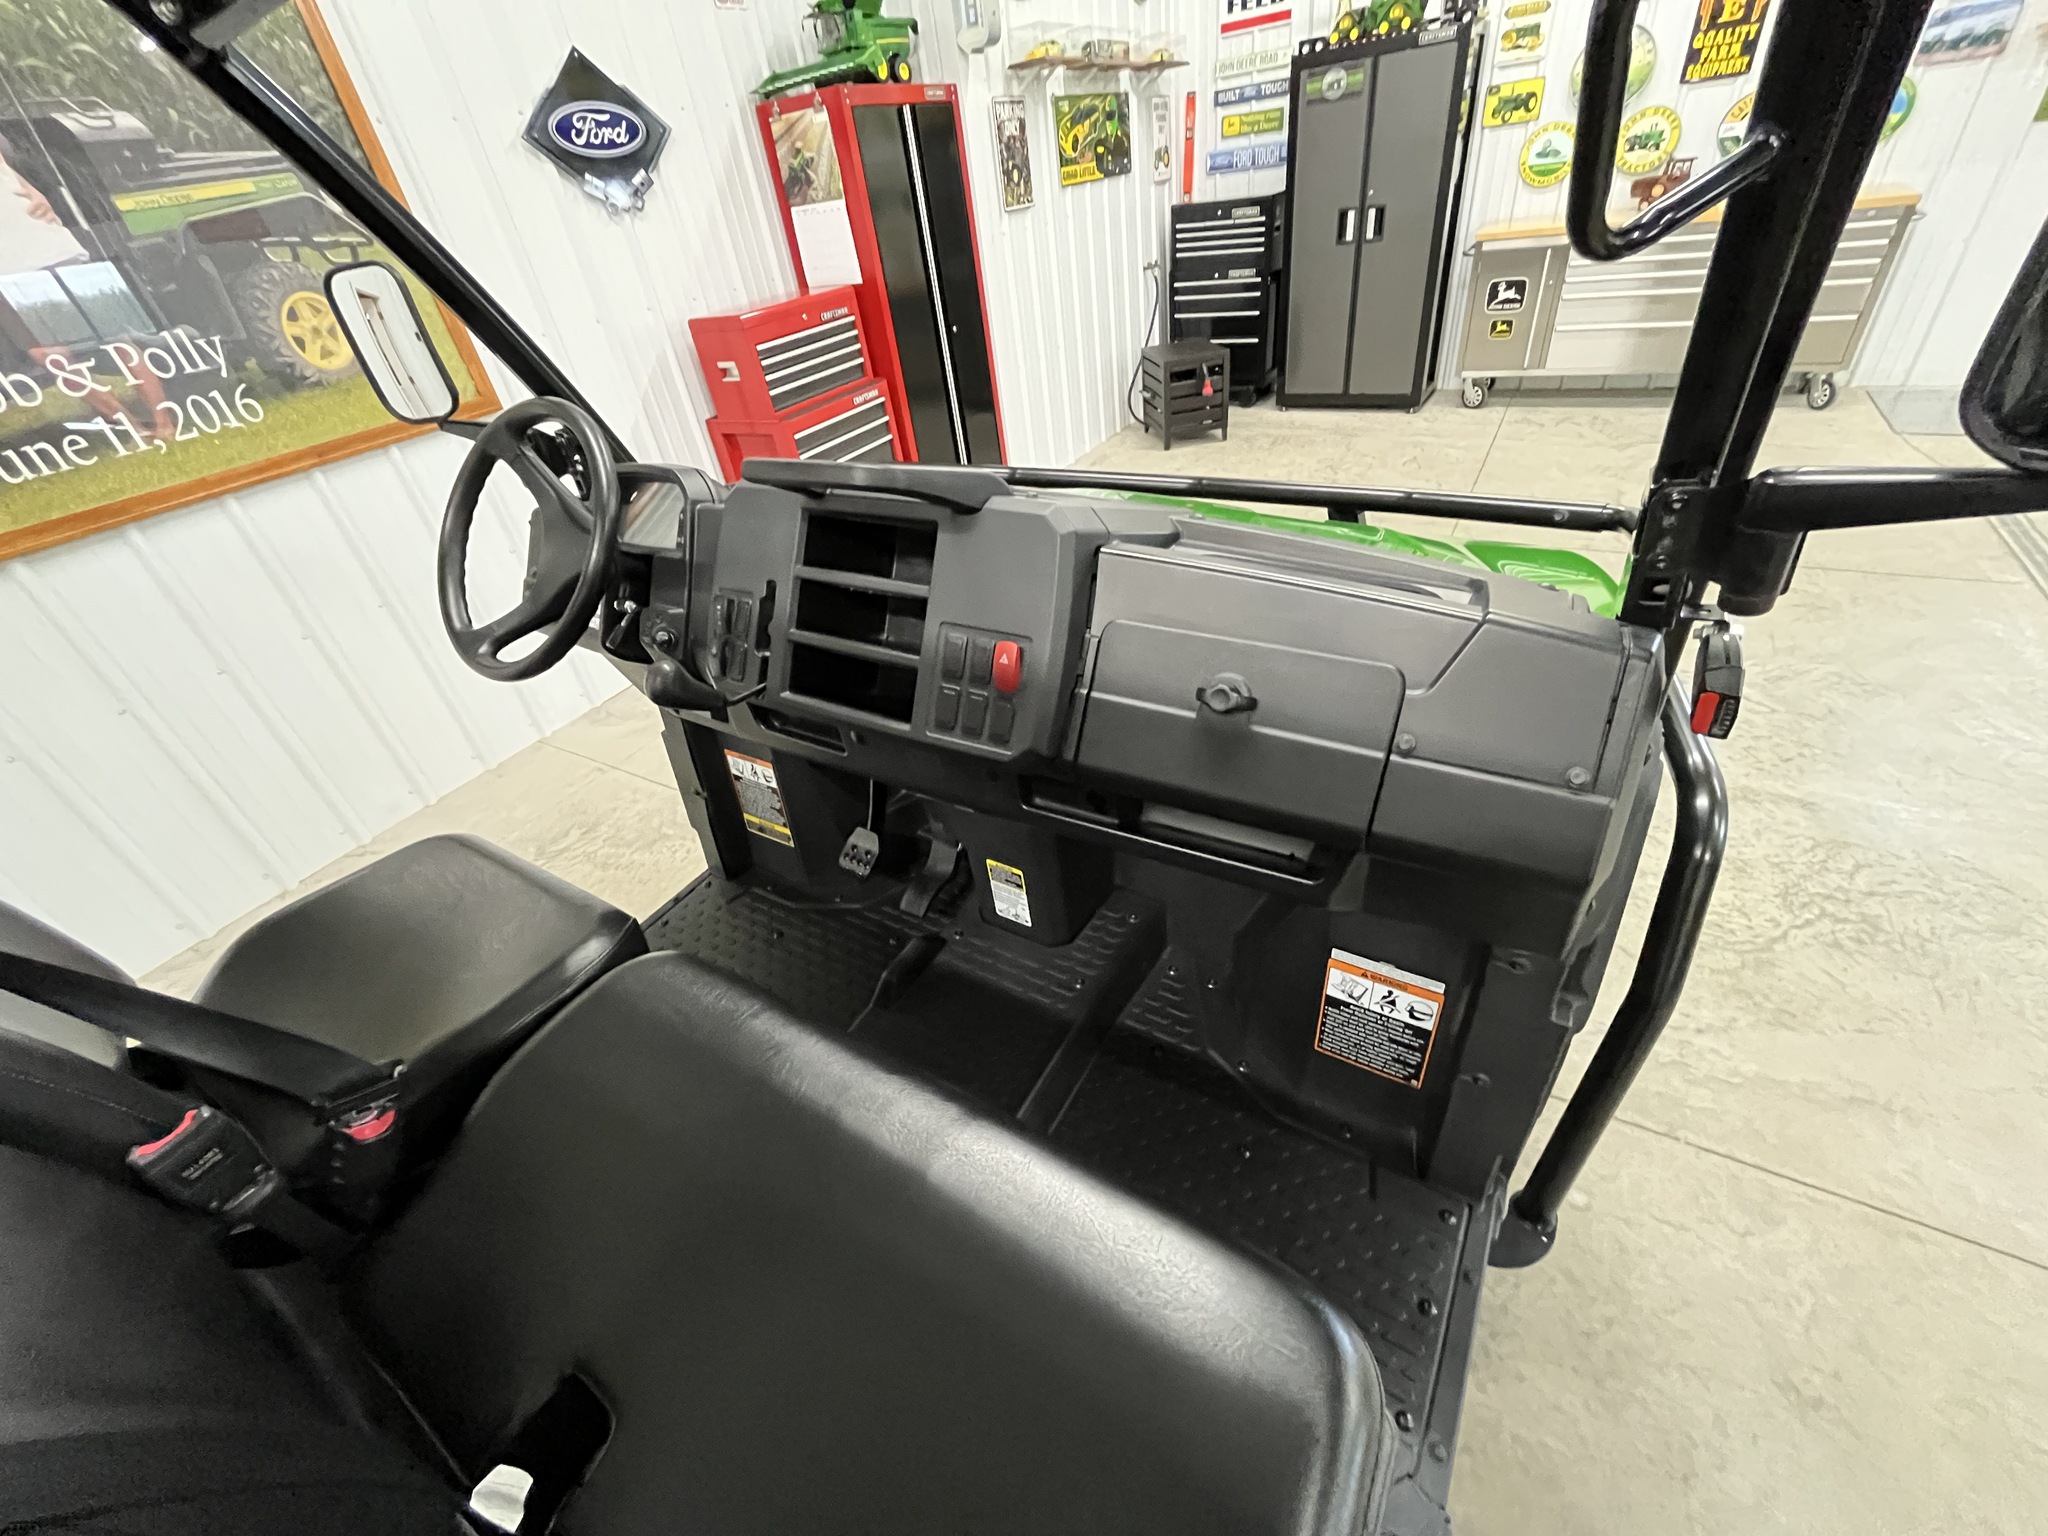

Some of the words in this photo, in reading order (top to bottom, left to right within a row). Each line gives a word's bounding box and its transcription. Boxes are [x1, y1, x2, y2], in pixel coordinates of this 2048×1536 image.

[1693, 23, 1760, 49] QUALITY
[1218, 61, 1235, 74] JOHN
[1236, 55, 1258, 71] DEERE
[1260, 53, 1279, 65] ROAD
[1701, 42, 1743, 65] FARM
[1685, 56, 1751, 81] EQUIPMENT
[1218, 89, 1240, 104] BUILT
[1260, 80, 1289, 96] TOUGH
[995, 103, 1025, 119] PARKING
[571, 112, 630, 146] Ford
[1233, 148, 1253, 168] FORD
[1255, 144, 1280, 166] TOUGH
[820, 306, 849, 322] CRAFTSMAN
[45, 354, 112, 398] &
[100, 327, 229, 387] Polly
[853, 389, 879, 406] CRAFTSMAN
[0, 433, 98, 485] une
[156, 382, 265, 442] 2016
